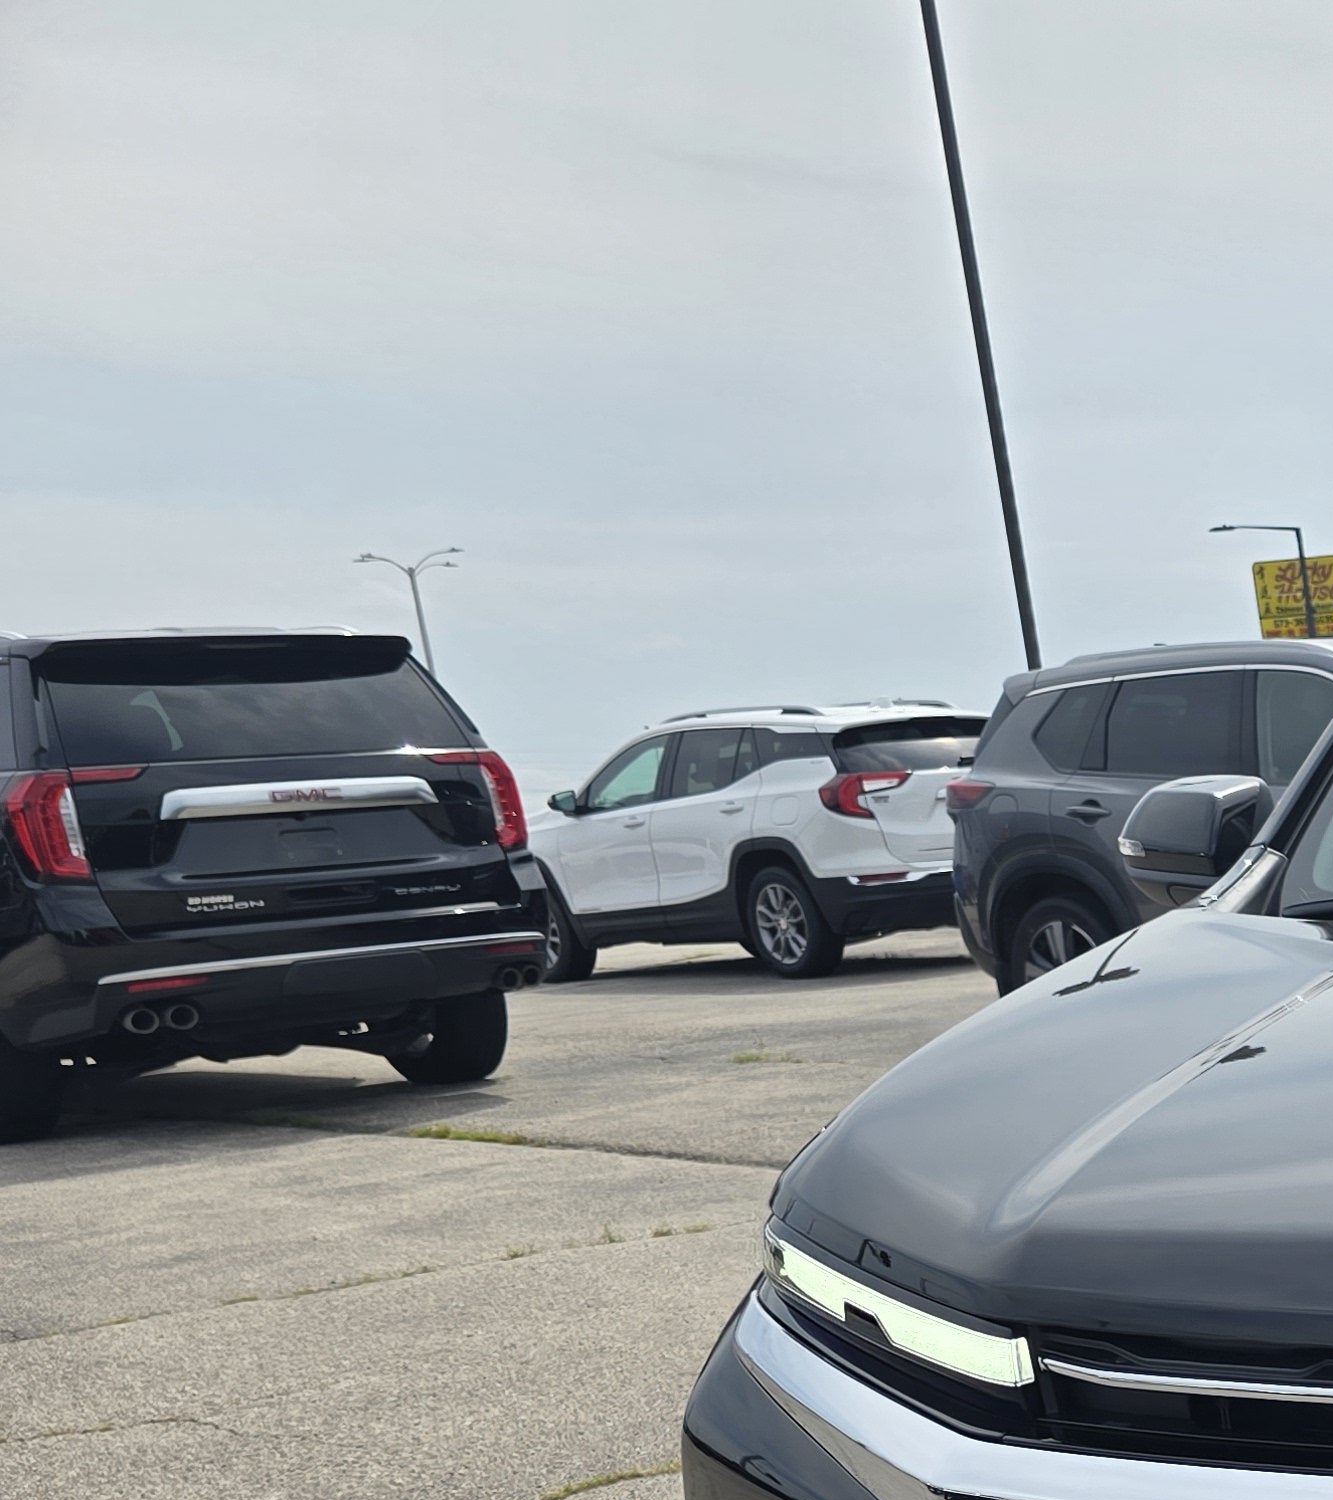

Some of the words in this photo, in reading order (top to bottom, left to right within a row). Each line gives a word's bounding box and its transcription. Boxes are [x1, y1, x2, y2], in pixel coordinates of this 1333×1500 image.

[1275, 561, 1333, 584] Luky
[270, 787, 343, 803] GMC
[186, 899, 265, 912] YUKON
